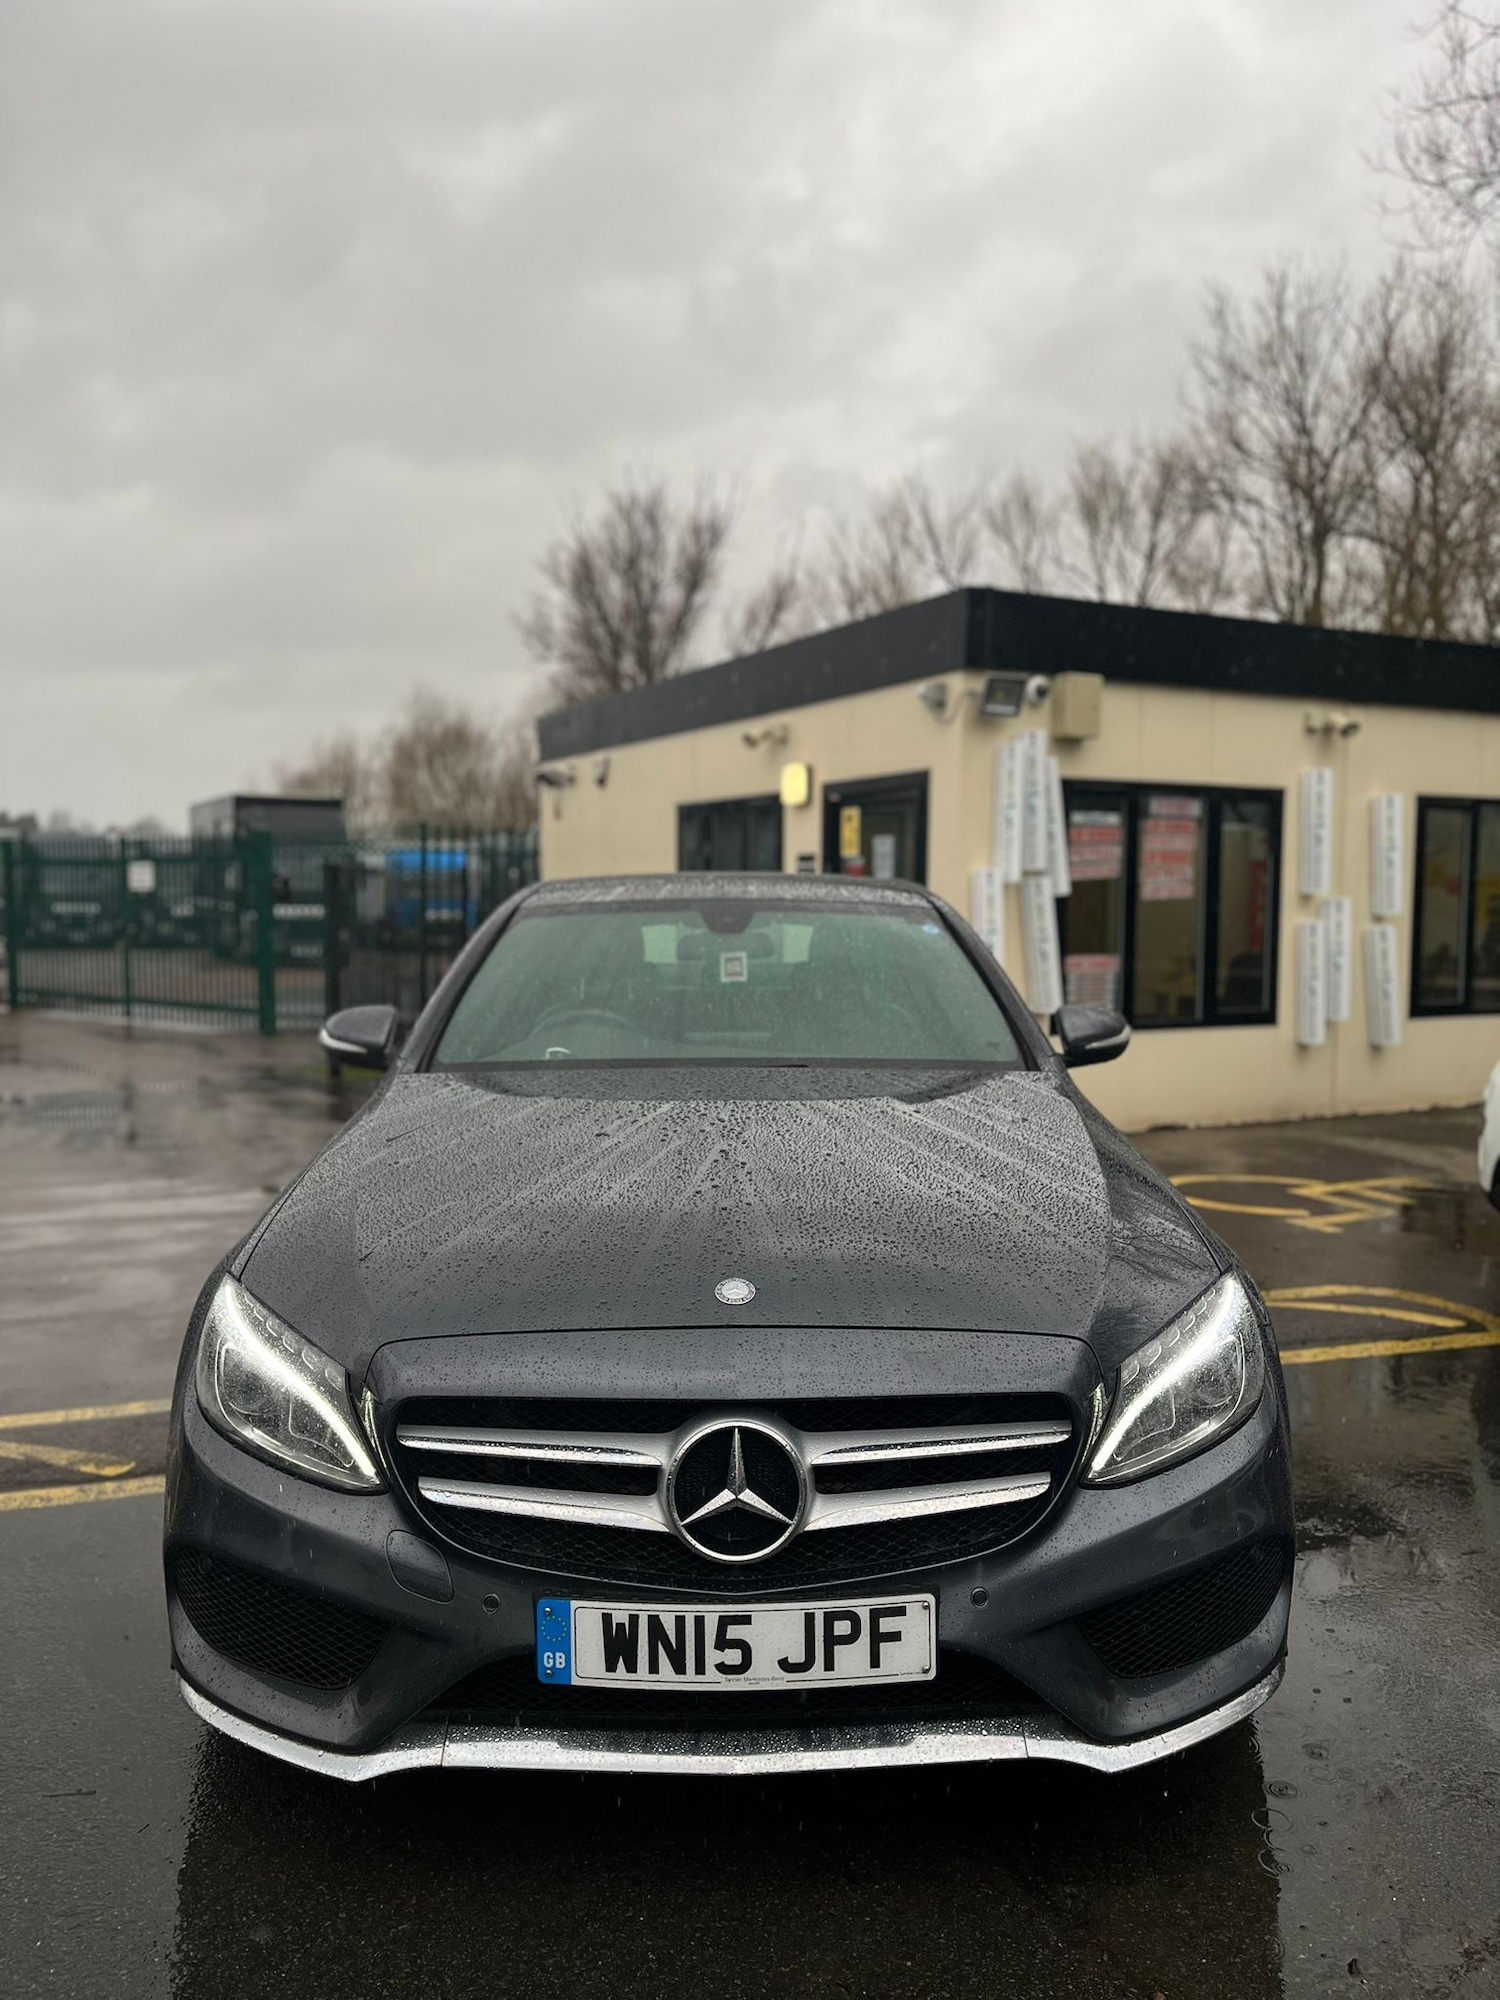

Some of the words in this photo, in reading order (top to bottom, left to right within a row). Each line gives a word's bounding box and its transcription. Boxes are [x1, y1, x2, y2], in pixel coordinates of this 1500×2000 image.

[543, 1651, 566, 1669] GB
[601, 1612, 753, 1676] WN15
[777, 1606, 908, 1674] JPF
